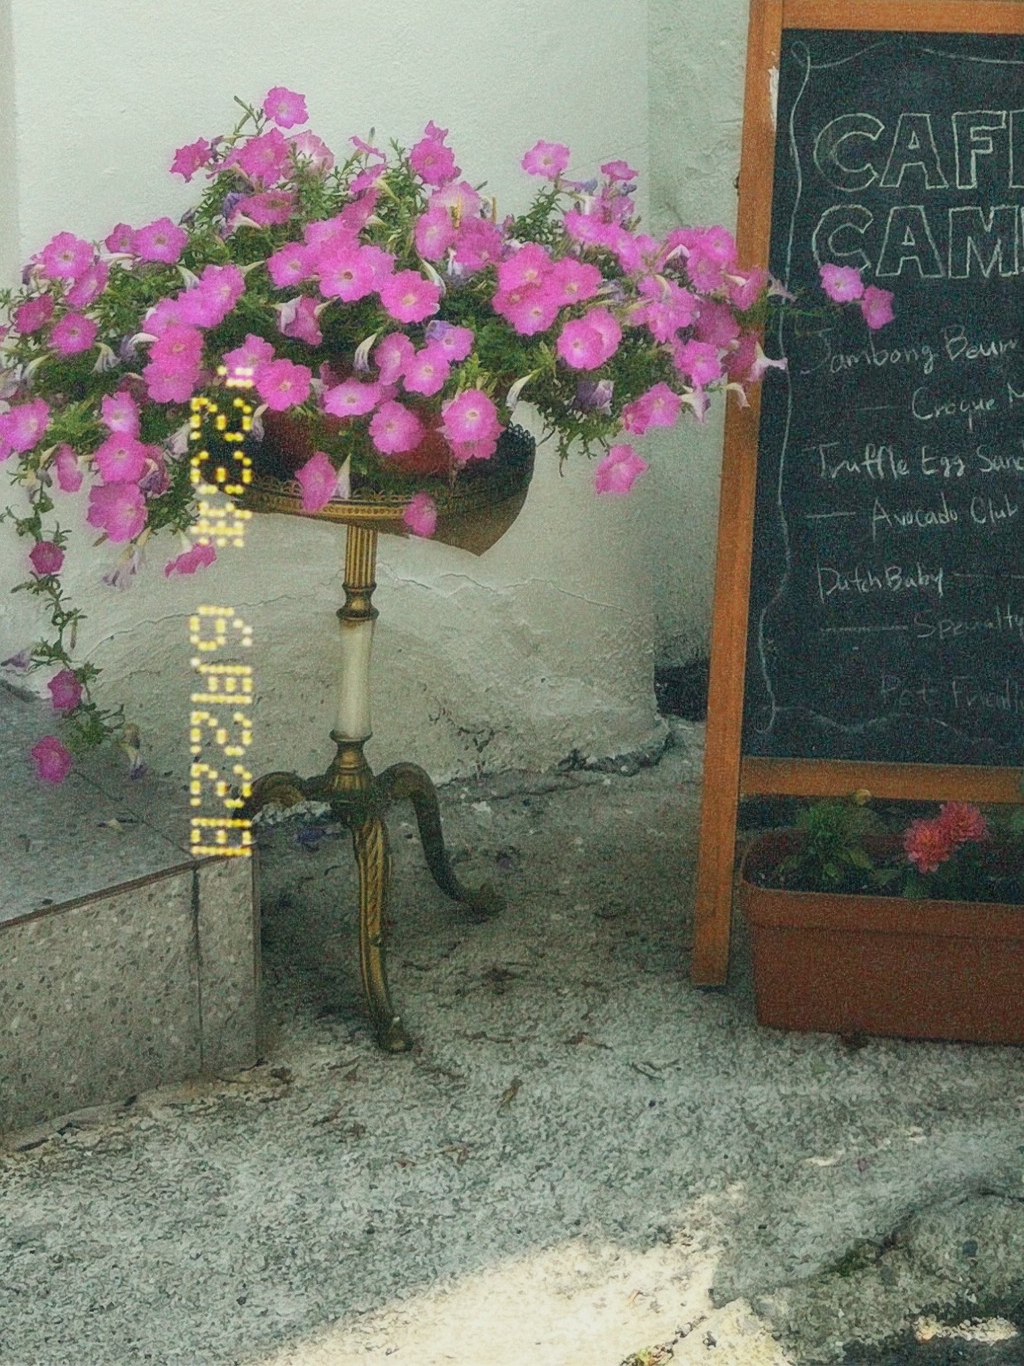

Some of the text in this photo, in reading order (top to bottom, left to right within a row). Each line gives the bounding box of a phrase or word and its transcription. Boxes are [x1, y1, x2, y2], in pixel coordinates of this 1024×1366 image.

[911, 386, 996, 431] Croque
[804, 441, 910, 480] Truffle
[921, 444, 966, 477] Egg
[871, 492, 959, 542] Avocado
[969, 492, 1019, 526] Club
